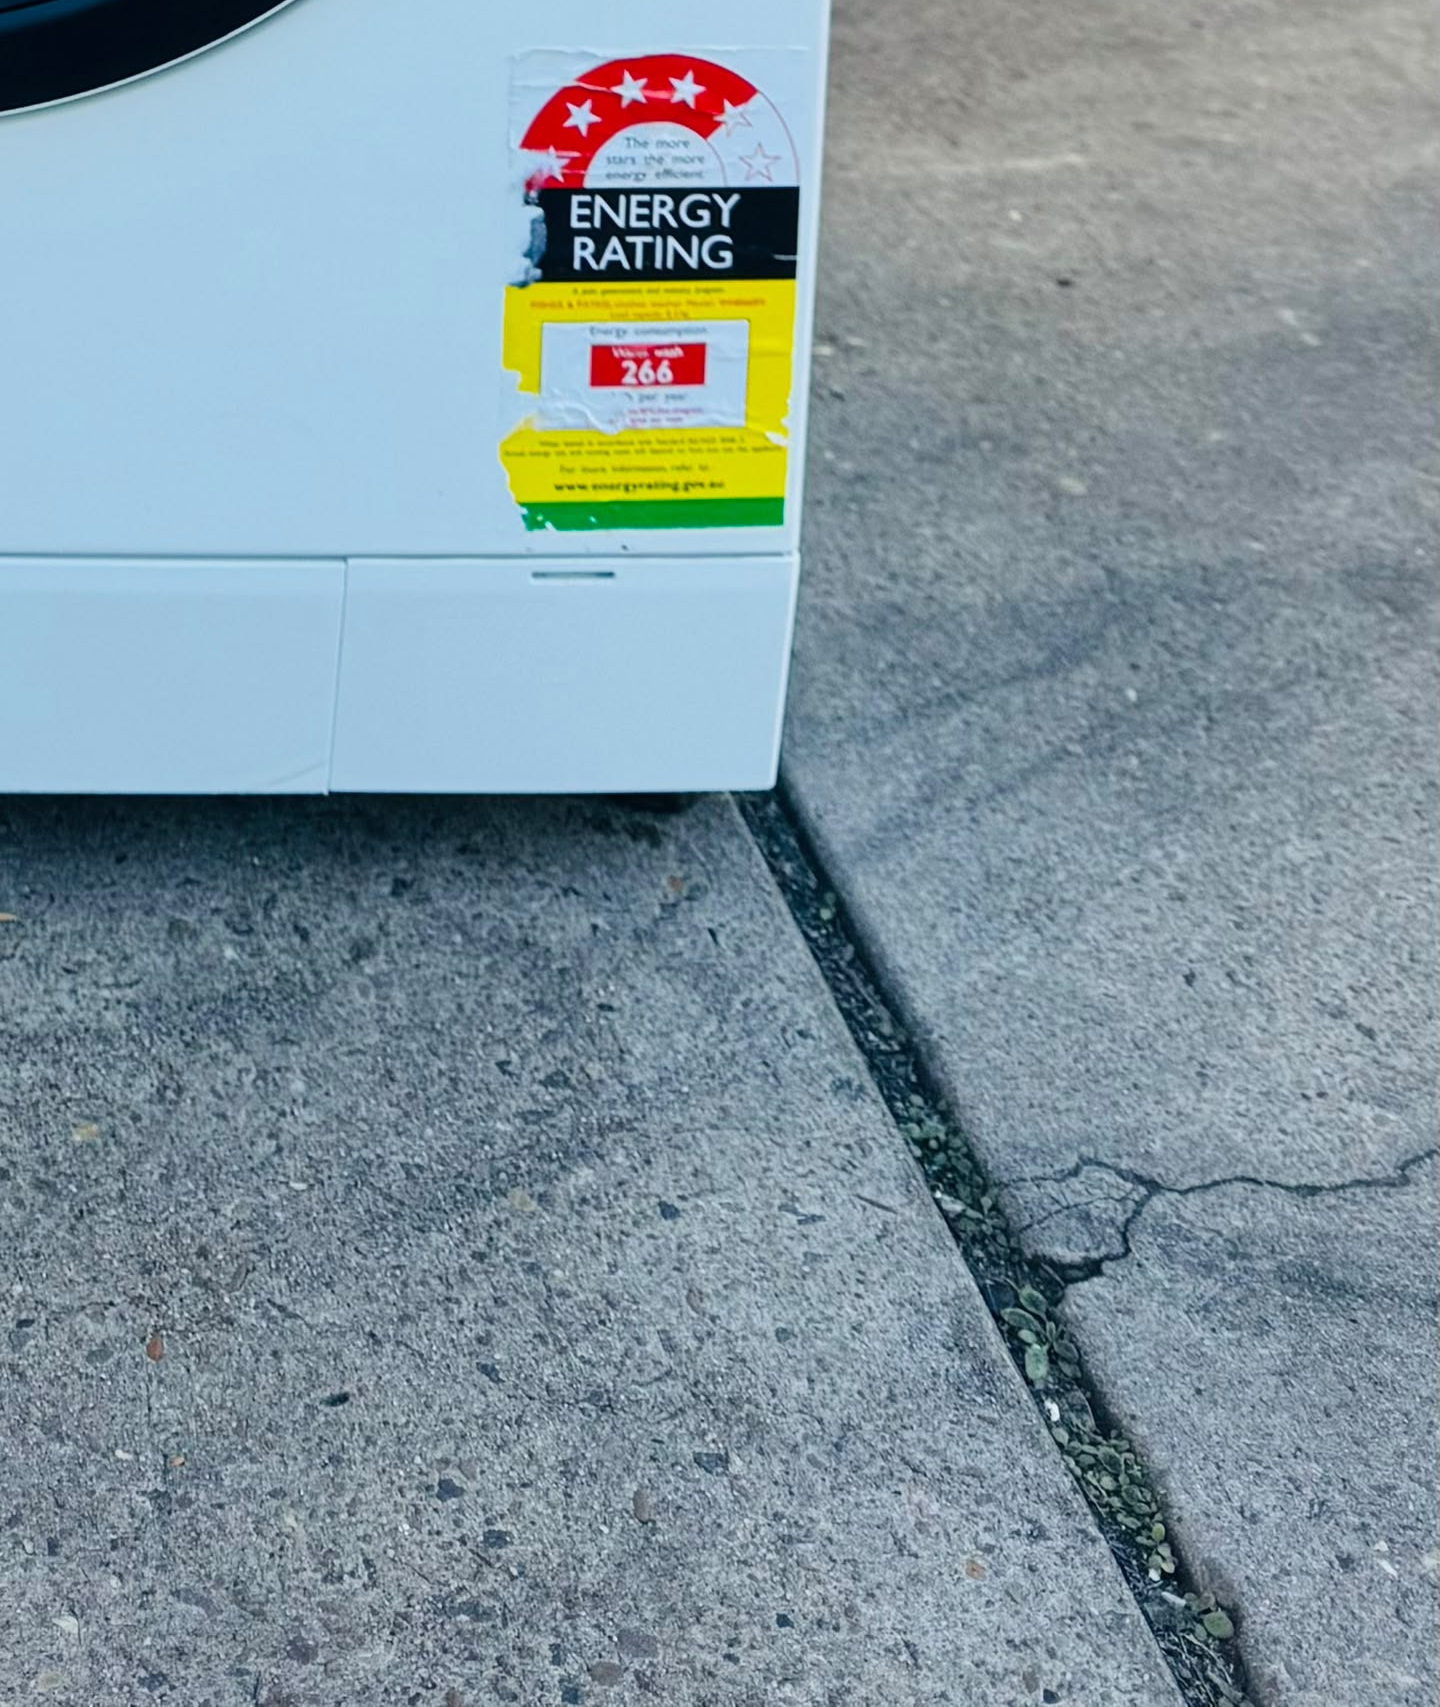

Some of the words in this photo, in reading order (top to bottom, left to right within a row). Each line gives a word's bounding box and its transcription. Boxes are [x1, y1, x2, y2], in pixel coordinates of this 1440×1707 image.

[569, 193, 741, 229] ENERGY
[572, 234, 734, 271] RATING
[621, 359, 674, 385] 266
